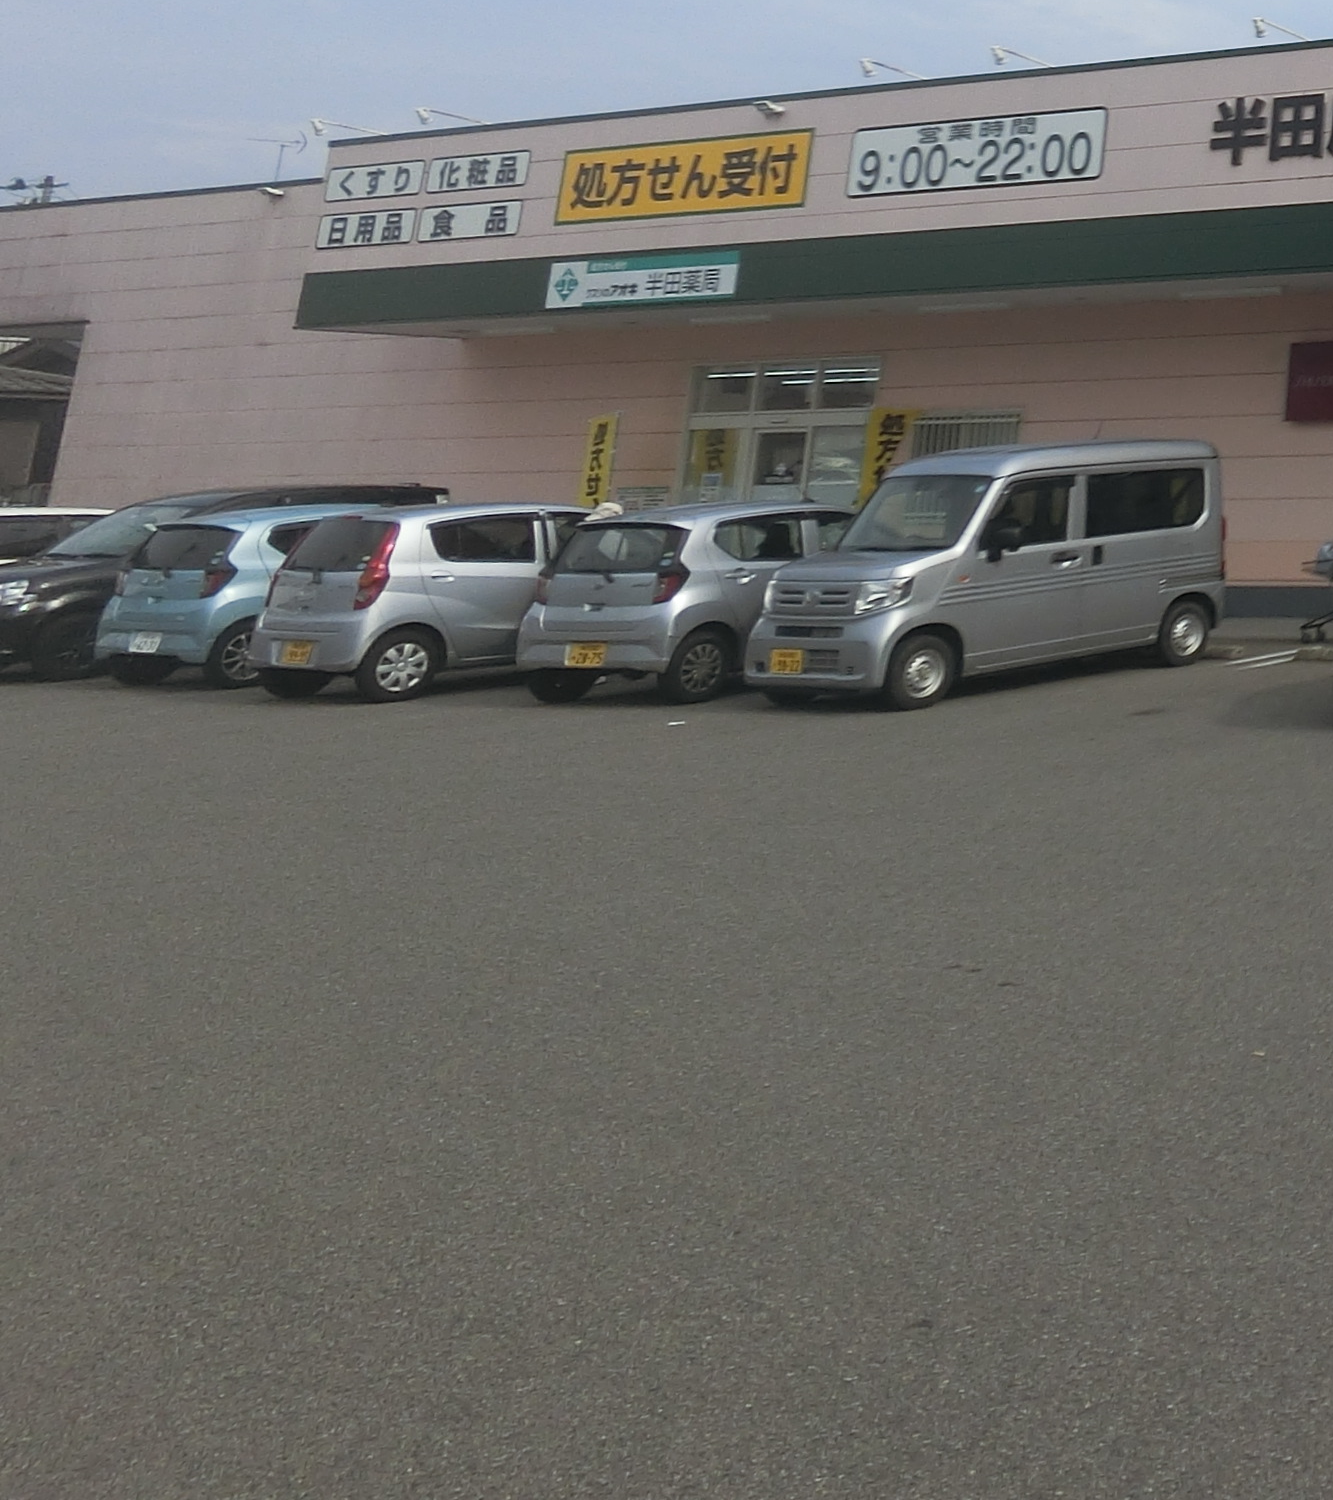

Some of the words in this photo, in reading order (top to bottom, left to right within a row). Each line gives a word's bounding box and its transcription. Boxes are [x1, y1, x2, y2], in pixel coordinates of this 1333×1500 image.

[918, 117, 1037, 144] 営業時間
[339, 166, 411, 196] くすり
[439, 156, 517, 189] 化粧品
[570, 143, 798, 211] 処方せん受付
[327, 213, 403, 245] 日用品
[430, 205, 508, 238] 食品
[644, 269, 721, 297] 半田薬局
